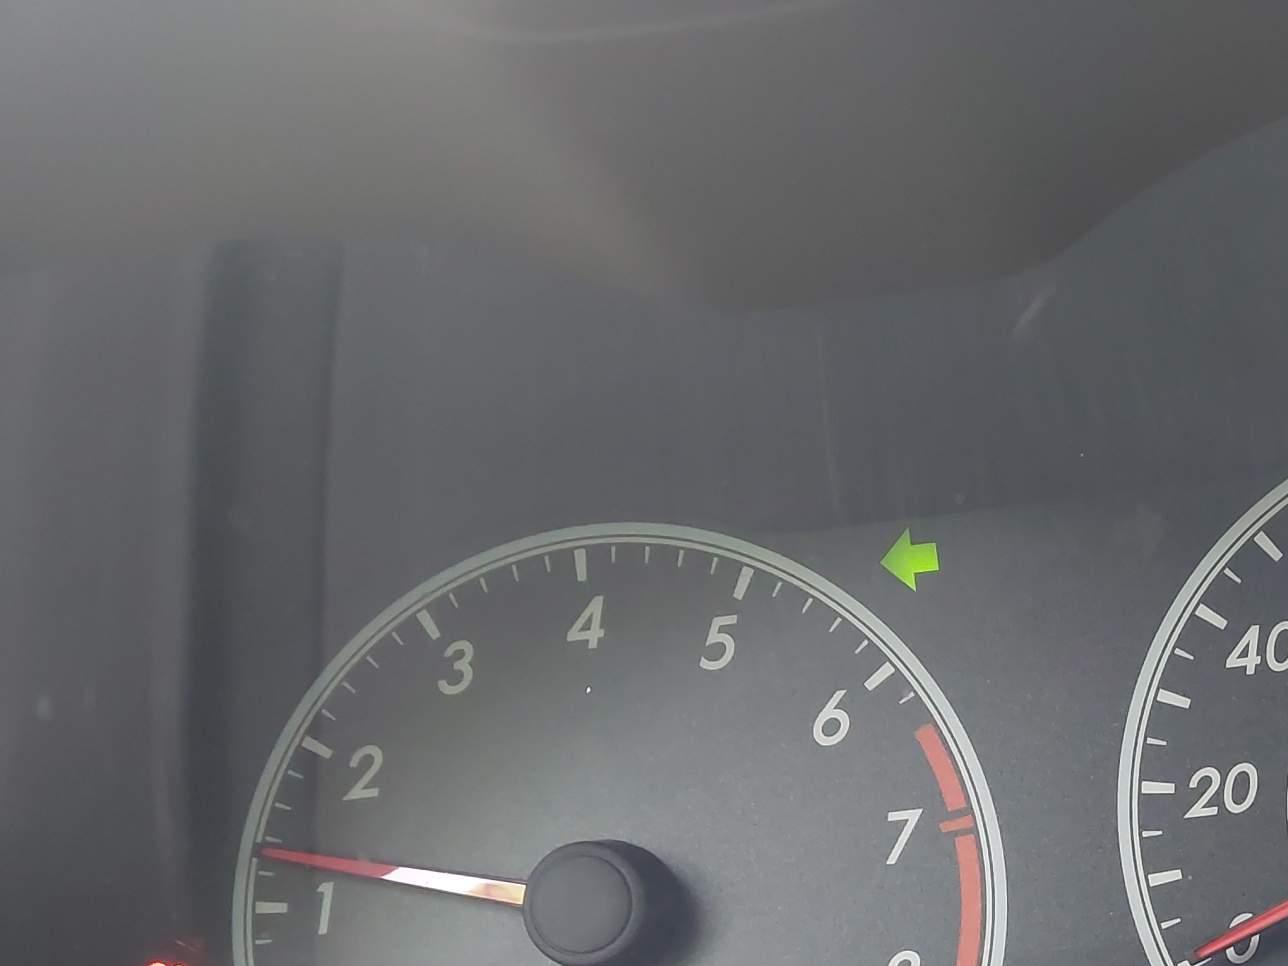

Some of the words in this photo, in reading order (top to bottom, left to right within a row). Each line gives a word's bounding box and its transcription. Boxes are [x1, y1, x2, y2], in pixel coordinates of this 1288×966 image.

[566, 595, 605, 649] 4
[699, 614, 738, 670] 5
[437, 639, 474, 695] 3
[812, 689, 850, 746] 6
[342, 744, 383, 801] 2
[1183, 762, 1258, 819] 20
[886, 808, 923, 865] 7
[316, 881, 334, 935] 1
